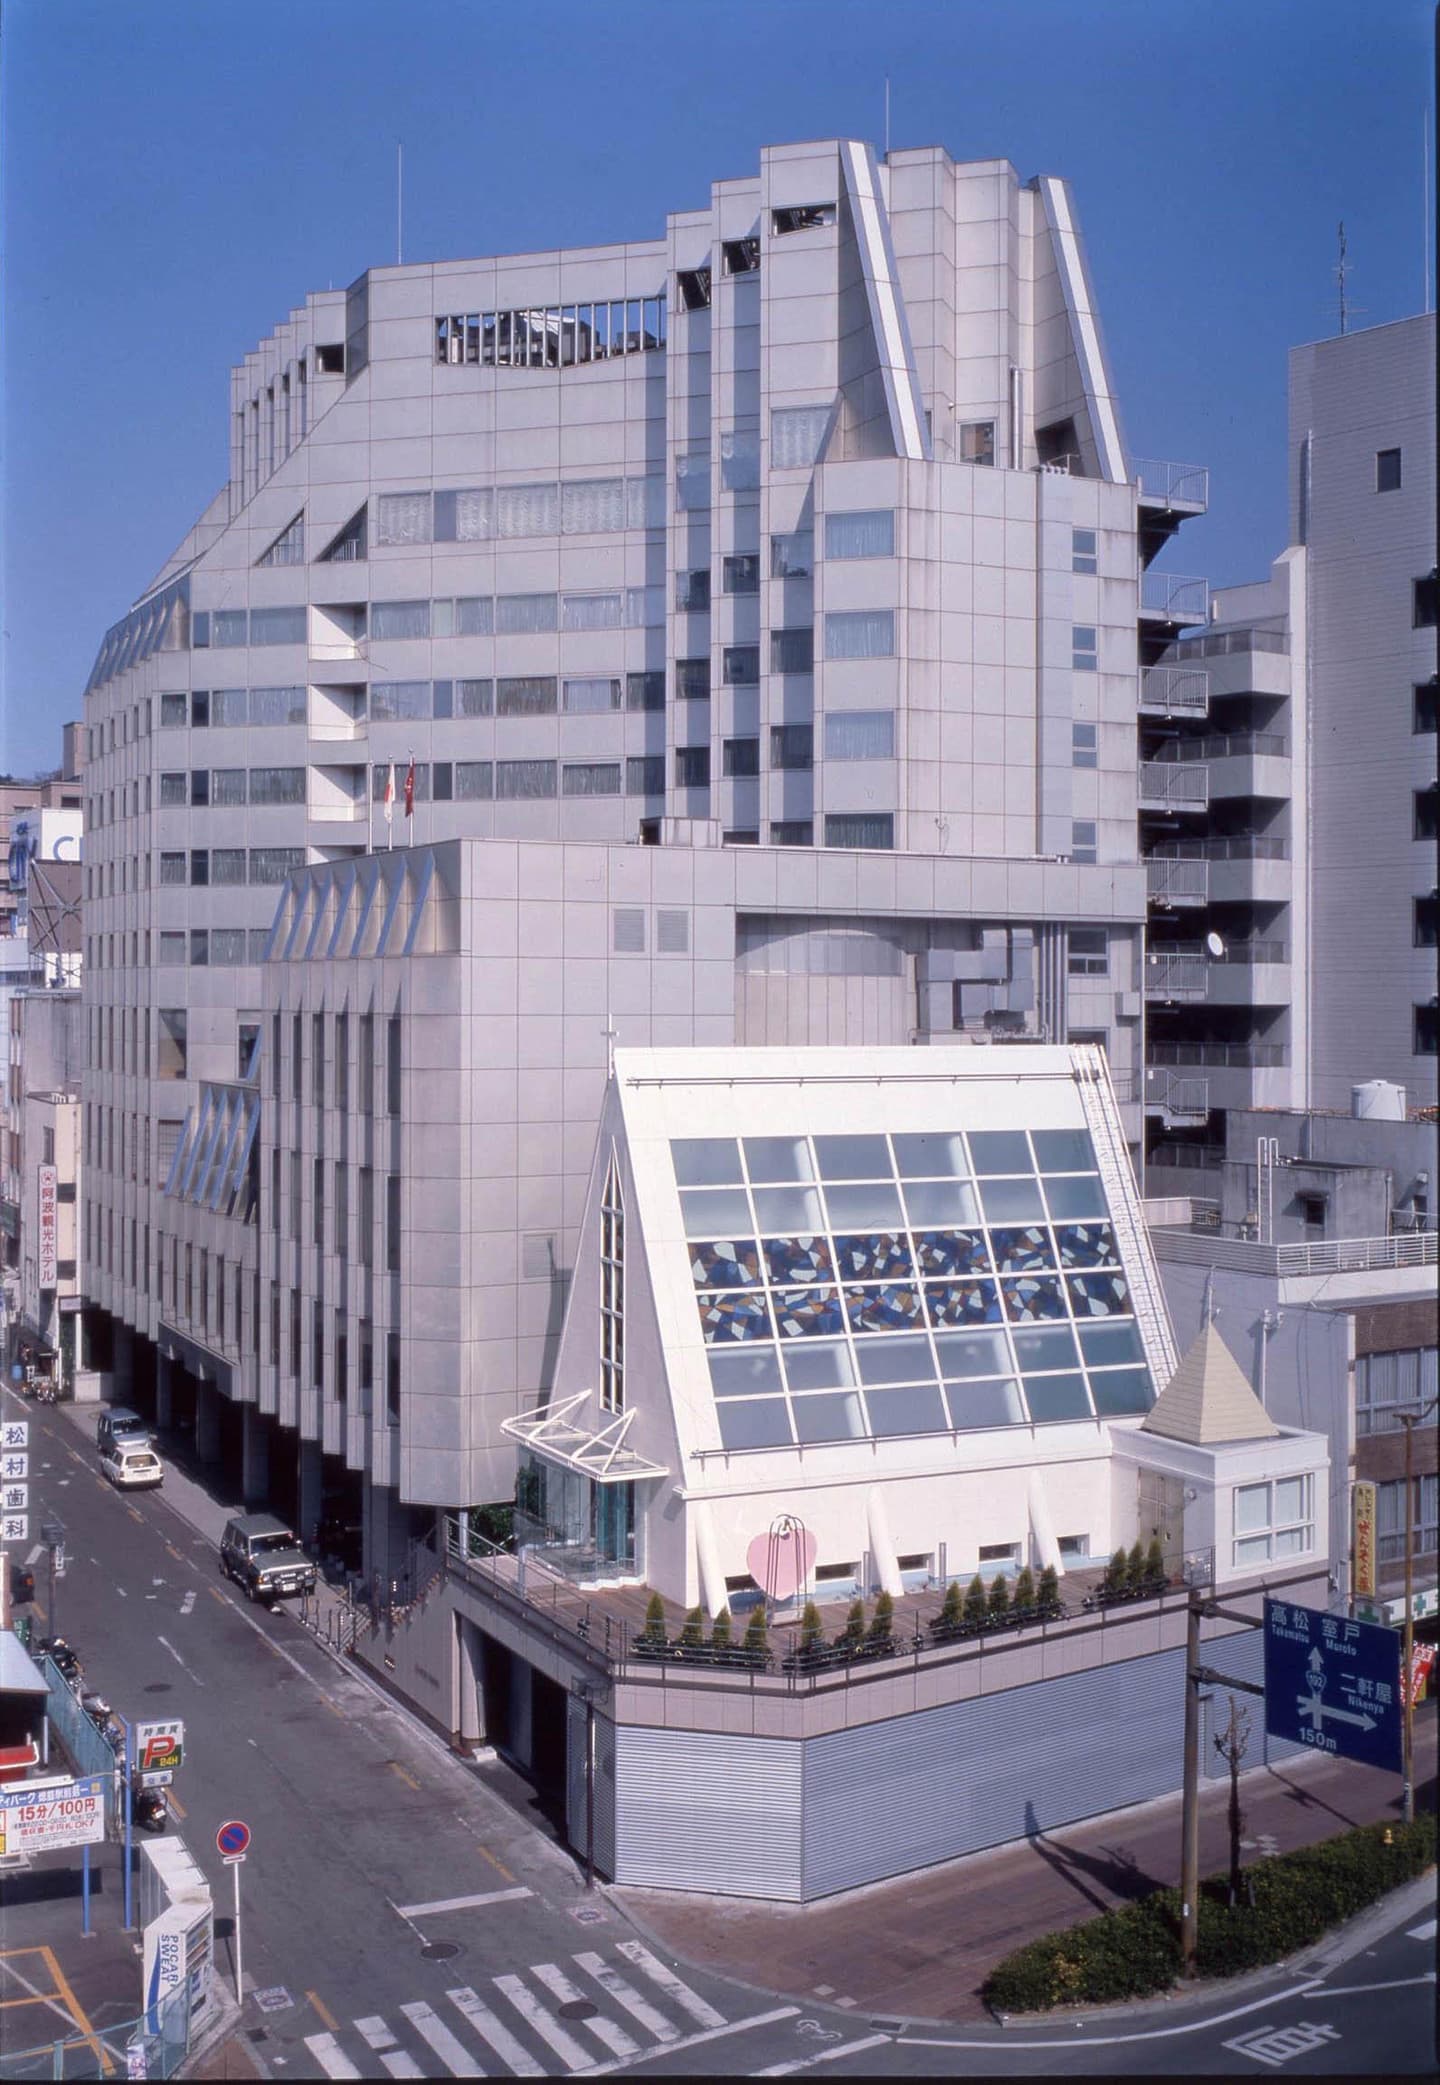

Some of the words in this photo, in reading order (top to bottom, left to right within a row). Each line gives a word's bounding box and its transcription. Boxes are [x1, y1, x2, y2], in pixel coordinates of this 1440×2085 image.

[41, 1187, 54, 1282] 阿波観光ホテル
[6, 1426, 25, 1537] 松村歯科
[1271, 1604, 1310, 1631] 高松
[1321, 1618, 1361, 1642] 室戸
[1272, 1624, 1310, 1643] Takamatsu
[1325, 1638, 1357, 1657] Muroto
[1340, 1672, 1393, 1704] 二軒屋
[1348, 1695, 1385, 1716] Nikenya
[143, 1736, 176, 1769] P
[1299, 1727, 1337, 1750] 150m
[18, 1798, 96, 1822] 15分/100円
[161, 1934, 170, 1983] SWEAT
